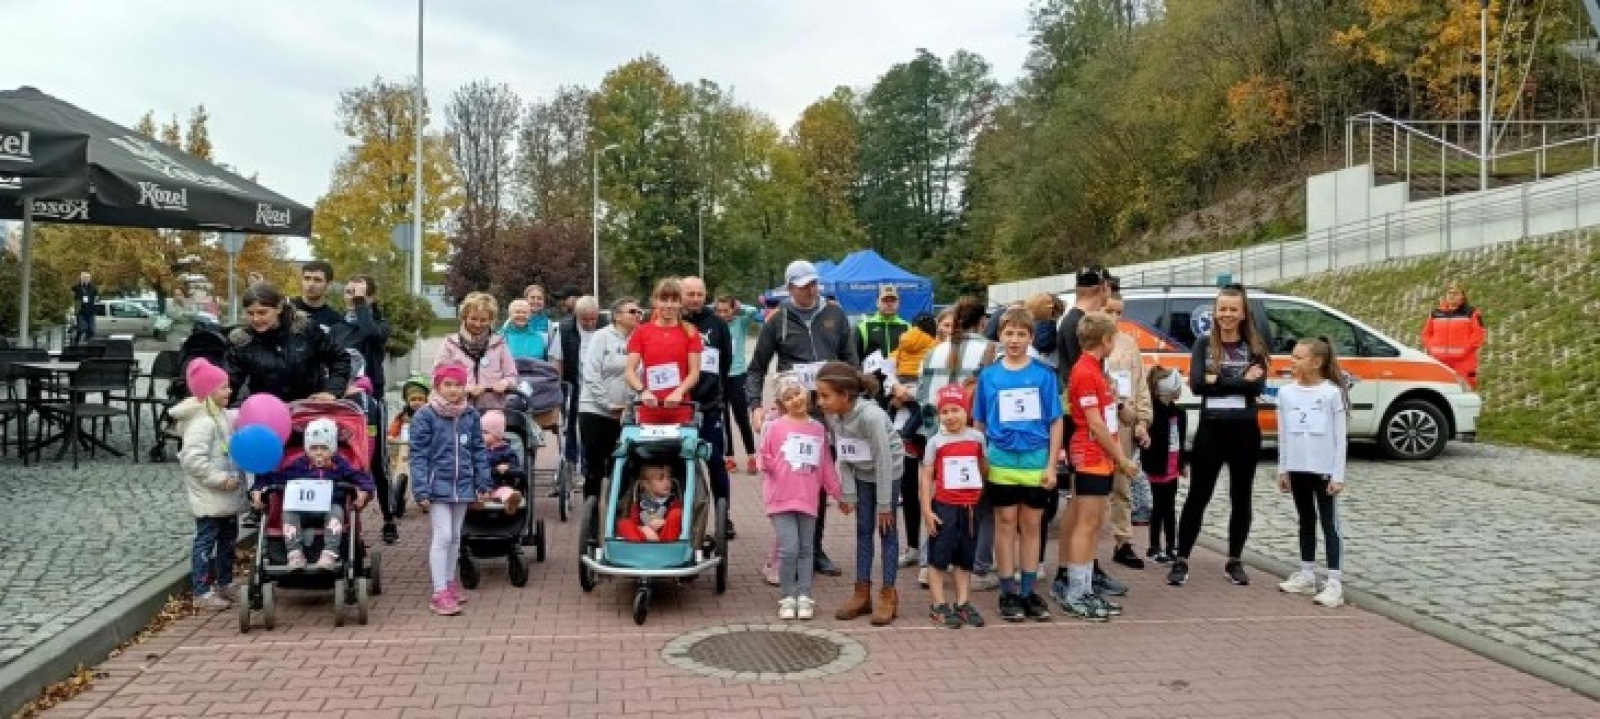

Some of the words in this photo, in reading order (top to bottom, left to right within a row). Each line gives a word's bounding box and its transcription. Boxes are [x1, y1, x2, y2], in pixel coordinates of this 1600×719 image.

[136, 181, 189, 211] Kozel
[1015, 398, 1025, 413] 5
[1299, 412, 1307, 424] 2
[960, 467, 970, 483] 5
[299, 488, 316, 501] 10
